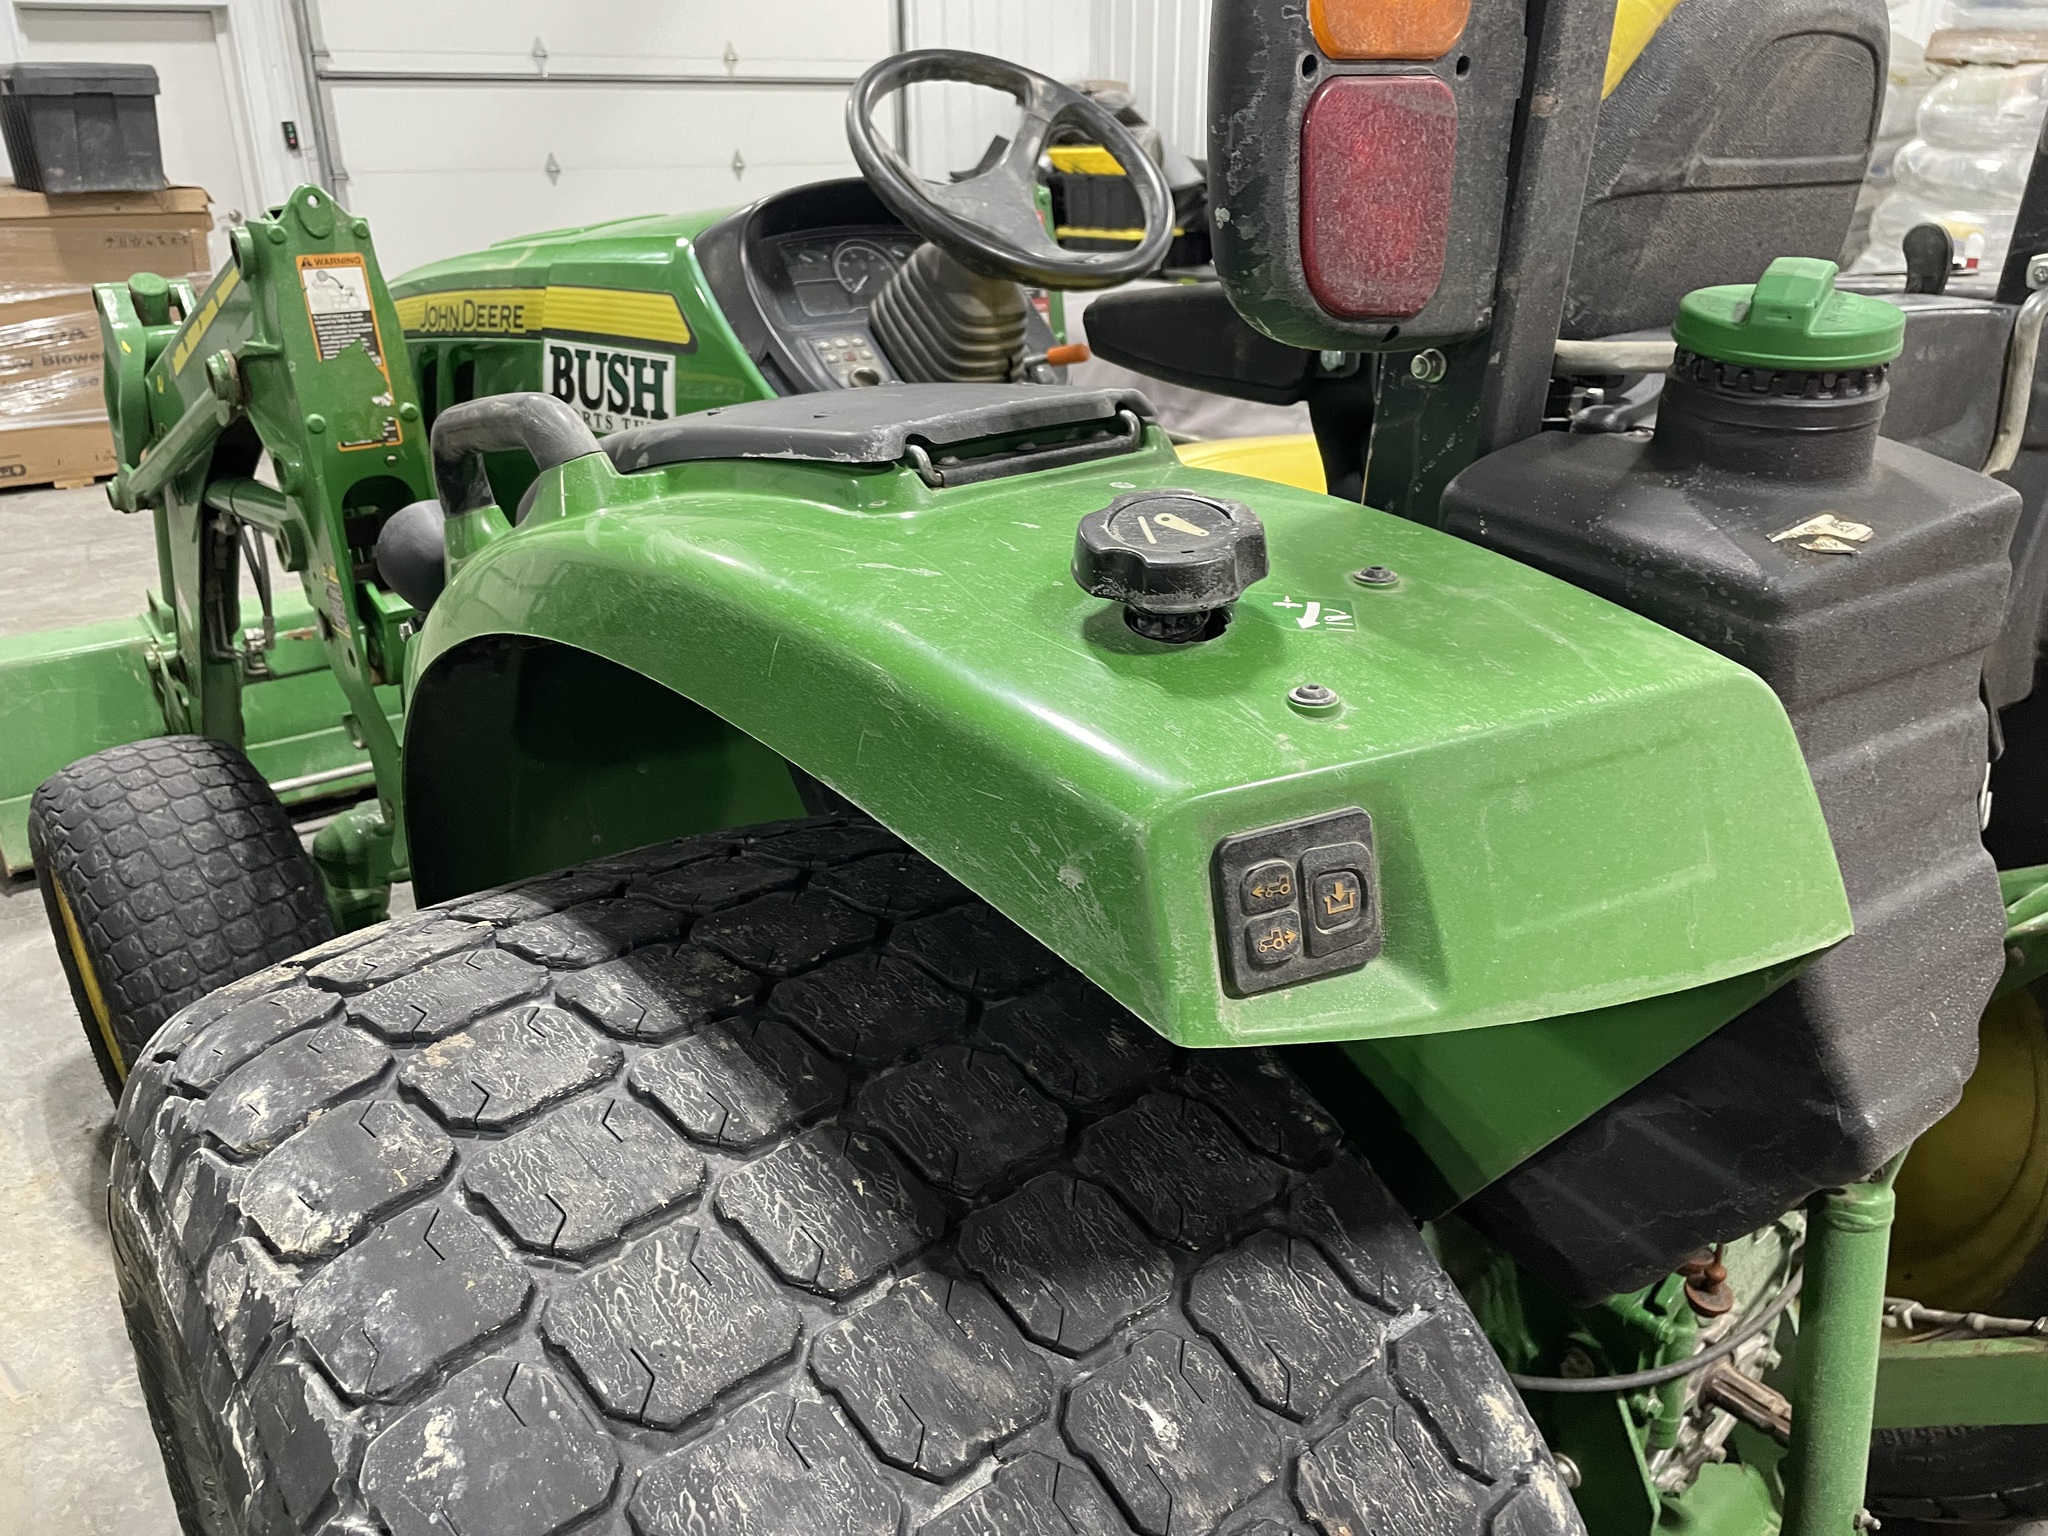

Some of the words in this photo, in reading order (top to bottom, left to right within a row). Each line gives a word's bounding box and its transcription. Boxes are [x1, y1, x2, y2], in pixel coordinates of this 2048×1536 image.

[420, 304, 460, 330] JOHN
[462, 300, 525, 329] DEERE
[550, 346, 668, 420] BUSH
